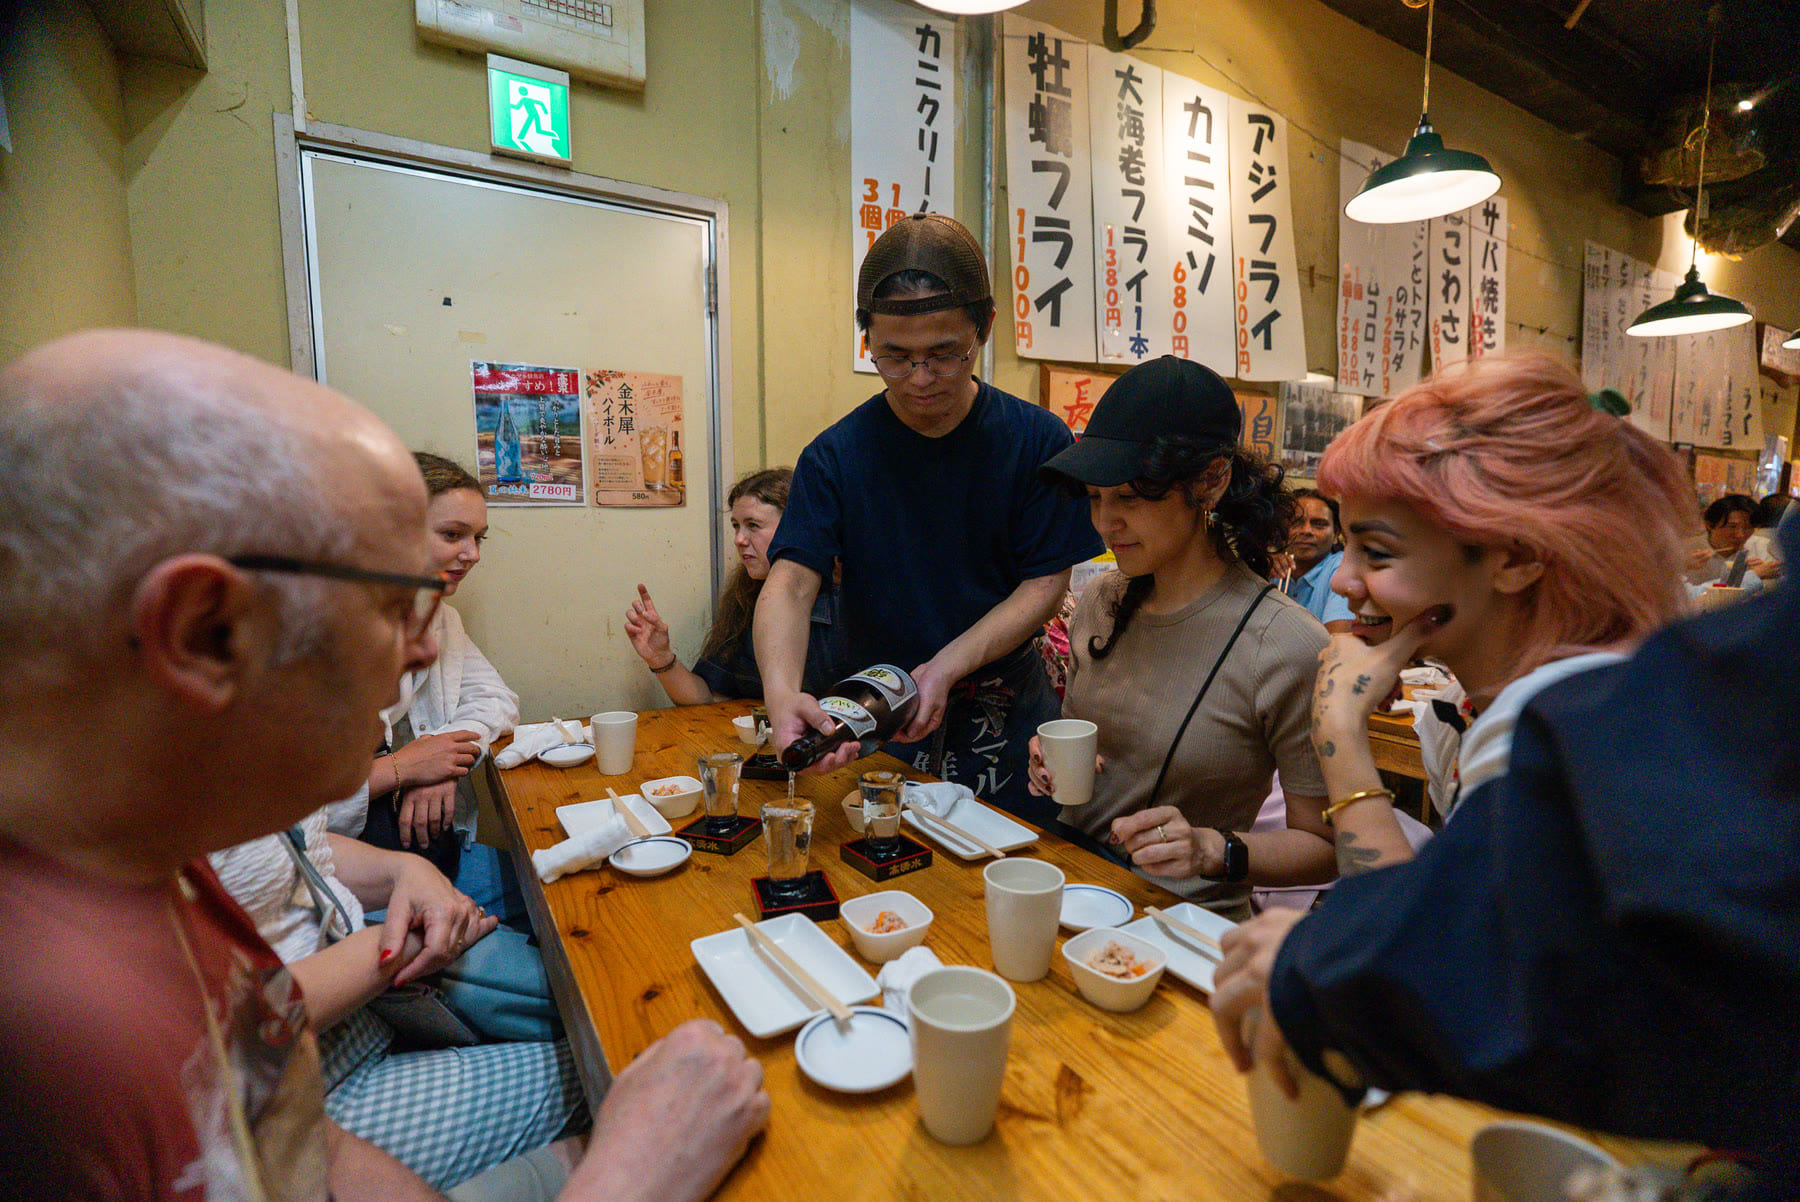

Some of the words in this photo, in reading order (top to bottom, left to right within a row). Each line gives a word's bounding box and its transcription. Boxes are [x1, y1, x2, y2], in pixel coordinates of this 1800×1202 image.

[1183, 95, 1216, 295] カニミソ
[1248, 113, 1282, 351] アジフライ
[1014, 208, 1032, 349] 1100円
[1106, 228, 1122, 328] 1380円
[1172, 261, 1189, 358] 680円
[1237, 257, 1251, 373] 1000円
[1481, 201, 1499, 350] サバ焼き
[1392, 285, 1408, 373] のサラダ
[602, 397, 616, 446] ハイボール
[617, 382, 635, 435] 金木犀
[533, 485, 572, 496] 2780円
